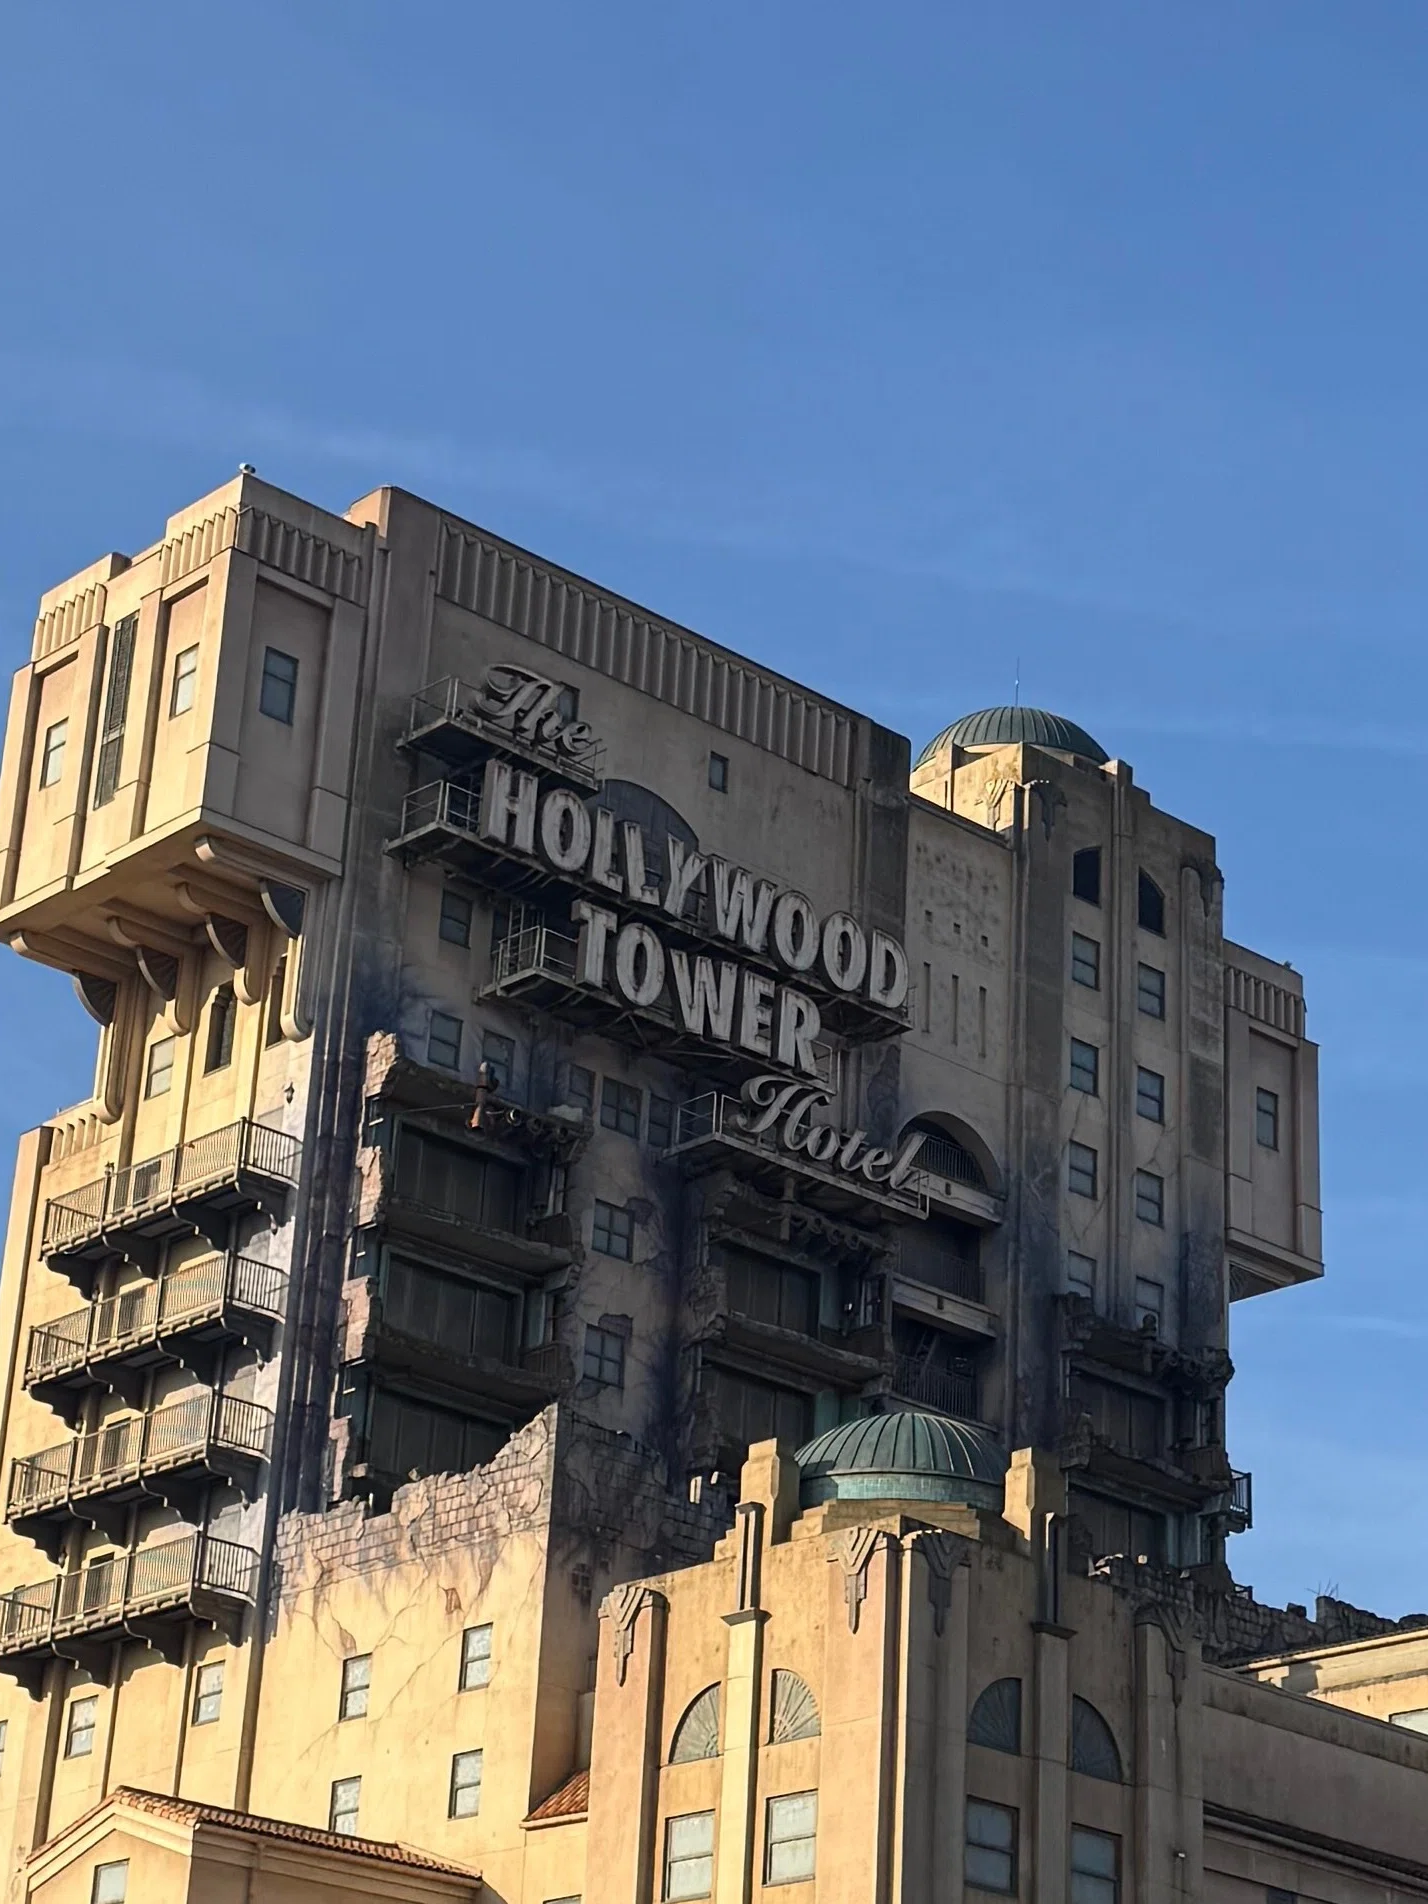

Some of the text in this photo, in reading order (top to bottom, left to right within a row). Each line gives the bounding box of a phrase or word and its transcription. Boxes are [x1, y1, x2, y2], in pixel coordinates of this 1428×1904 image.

[475, 663, 596, 755] The
[480, 757, 909, 1010] HOLLYWOOD
[573, 899, 822, 1079] TOWER
[732, 1074, 930, 1191] Hotel
